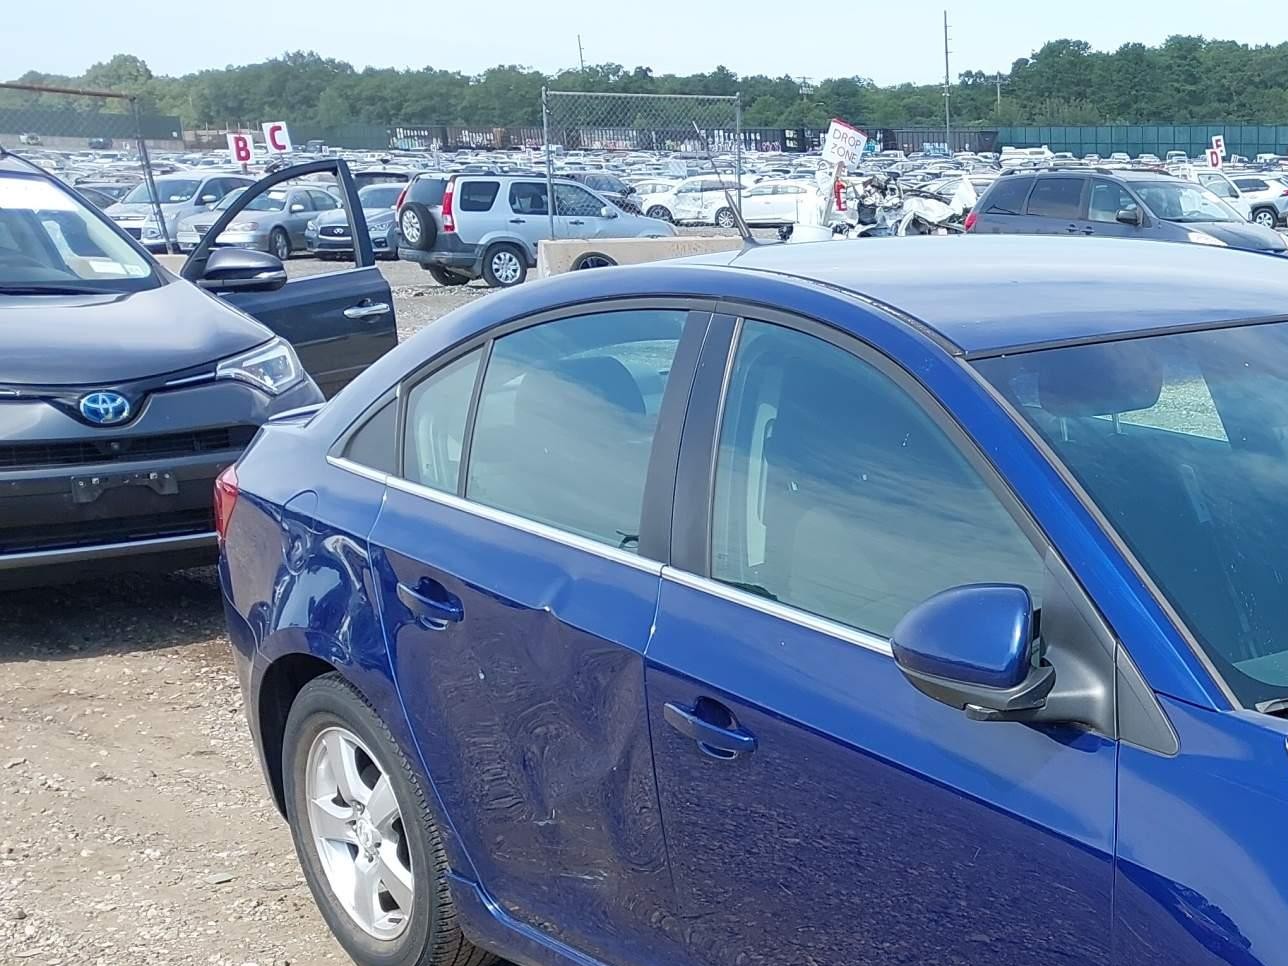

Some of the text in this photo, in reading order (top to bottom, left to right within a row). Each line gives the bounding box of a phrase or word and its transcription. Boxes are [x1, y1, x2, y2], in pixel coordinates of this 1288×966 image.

[234, 136, 251, 161] B
[270, 126, 286, 150] C
[833, 129, 861, 149] DROP
[831, 143, 857, 164] ZONE
[1210, 151, 1219, 167] D
